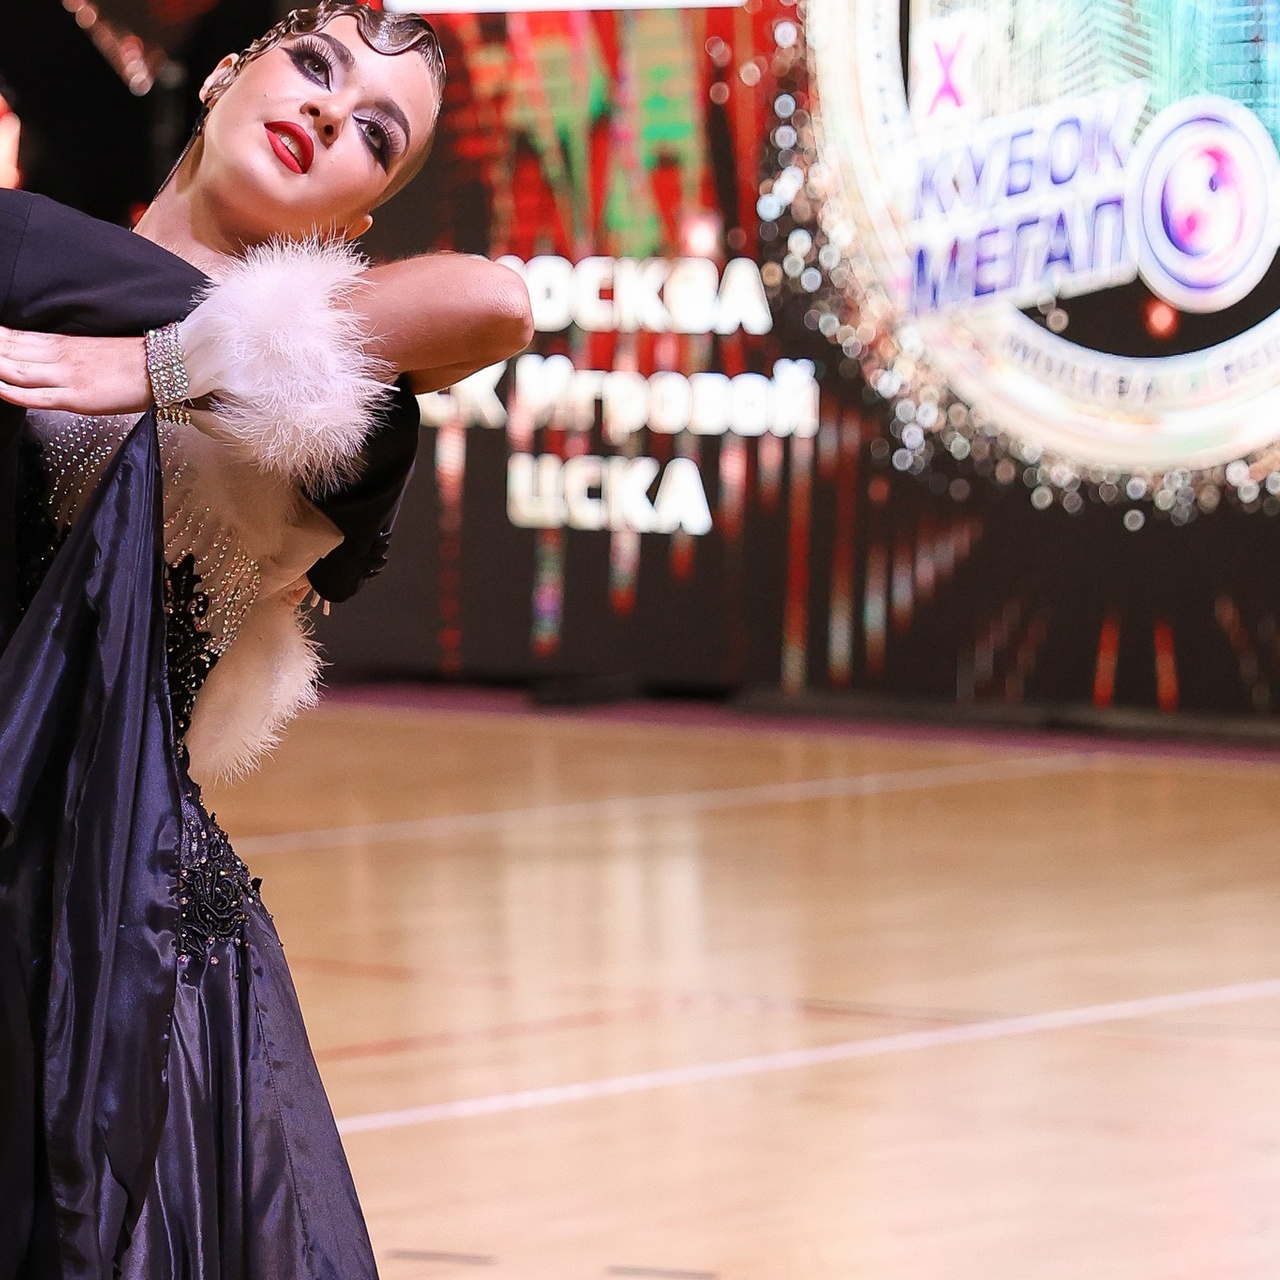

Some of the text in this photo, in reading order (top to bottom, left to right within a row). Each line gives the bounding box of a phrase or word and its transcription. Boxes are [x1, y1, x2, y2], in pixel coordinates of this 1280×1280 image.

[914, 115, 1132, 222] КУБОК
[476, 254, 774, 336] ОСКВА
[514, 354, 820, 446] Игровой
[507, 452, 714, 535] ЦСКА
